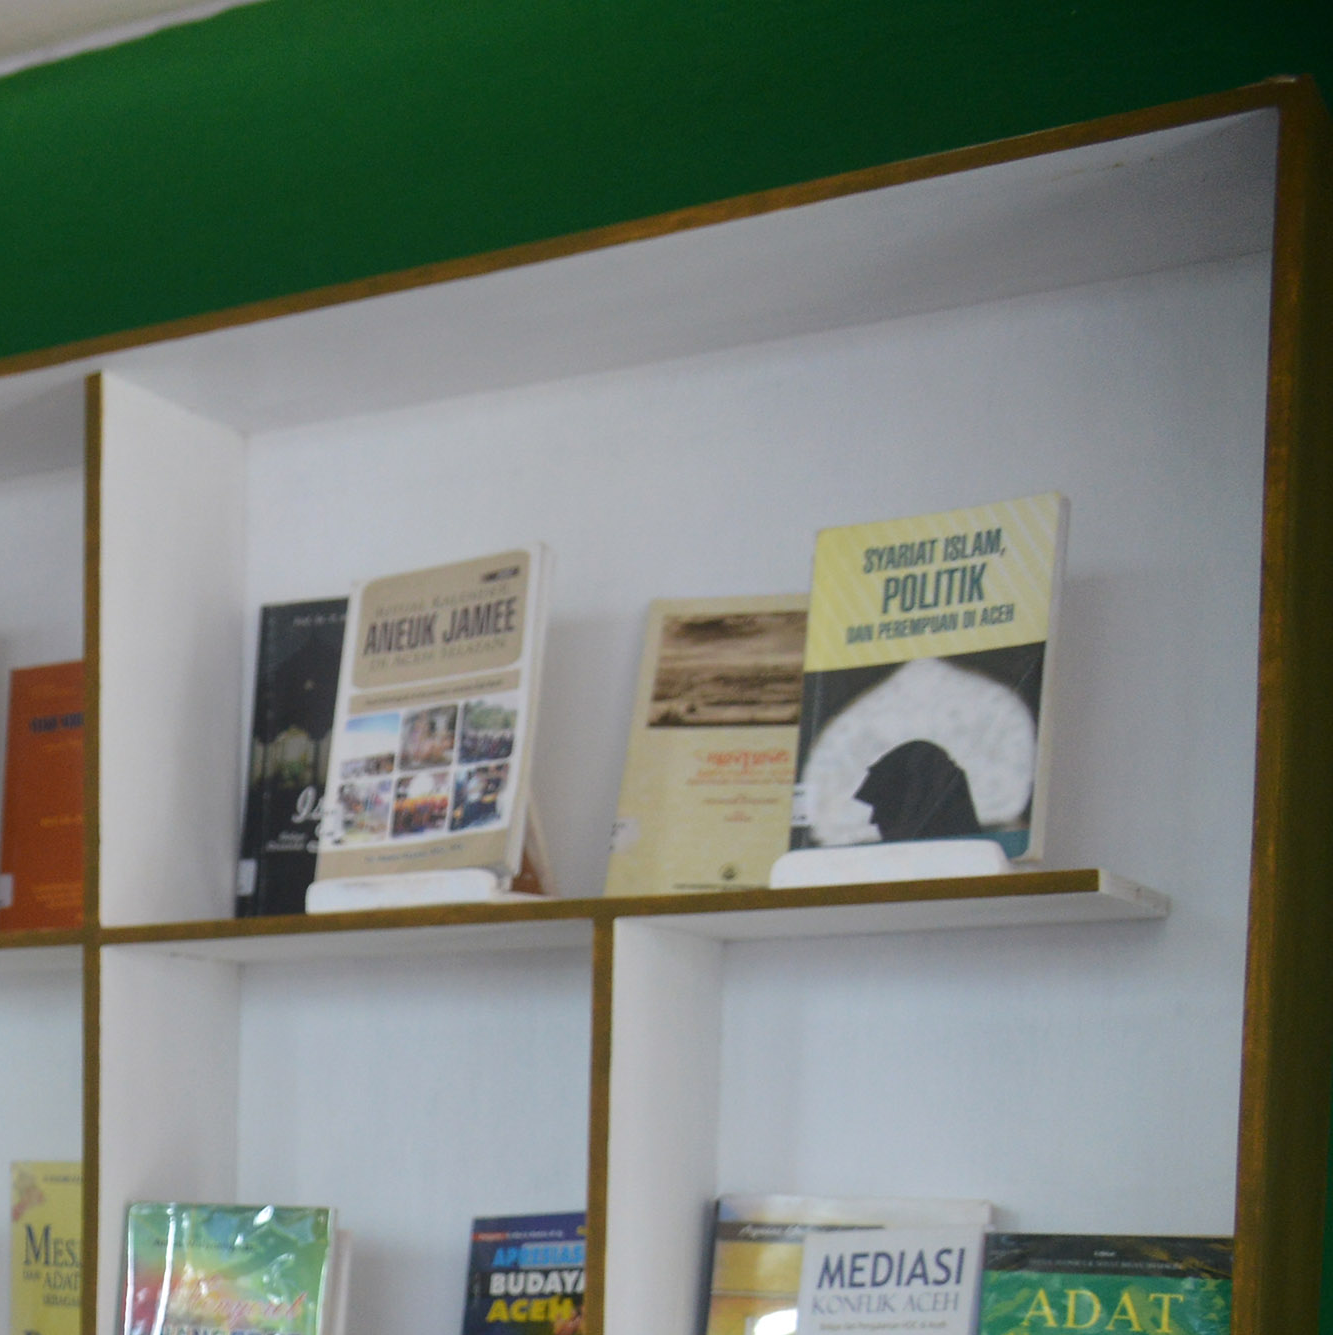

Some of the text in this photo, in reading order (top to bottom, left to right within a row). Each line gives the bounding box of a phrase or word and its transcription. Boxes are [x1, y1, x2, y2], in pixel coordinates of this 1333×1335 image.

[863, 527, 1006, 574] SYARIAT ISLAM,
[882, 562, 987, 614] POLITIK
[363, 611, 438, 657] ANEUK
[442, 596, 517, 644] JAMEE
[878, 611, 959, 640] PEREMPUAN
[980, 603, 1015, 627] ACEH
[23, 1223, 82, 1268] MES
[492, 1246, 586, 1268] APRESIAS
[817, 1247, 966, 1289] MEDIASI
[486, 1296, 574, 1323] ACEH
[903, 1291, 960, 1313] ACEH
[1020, 1288, 1184, 1334] ADAT
